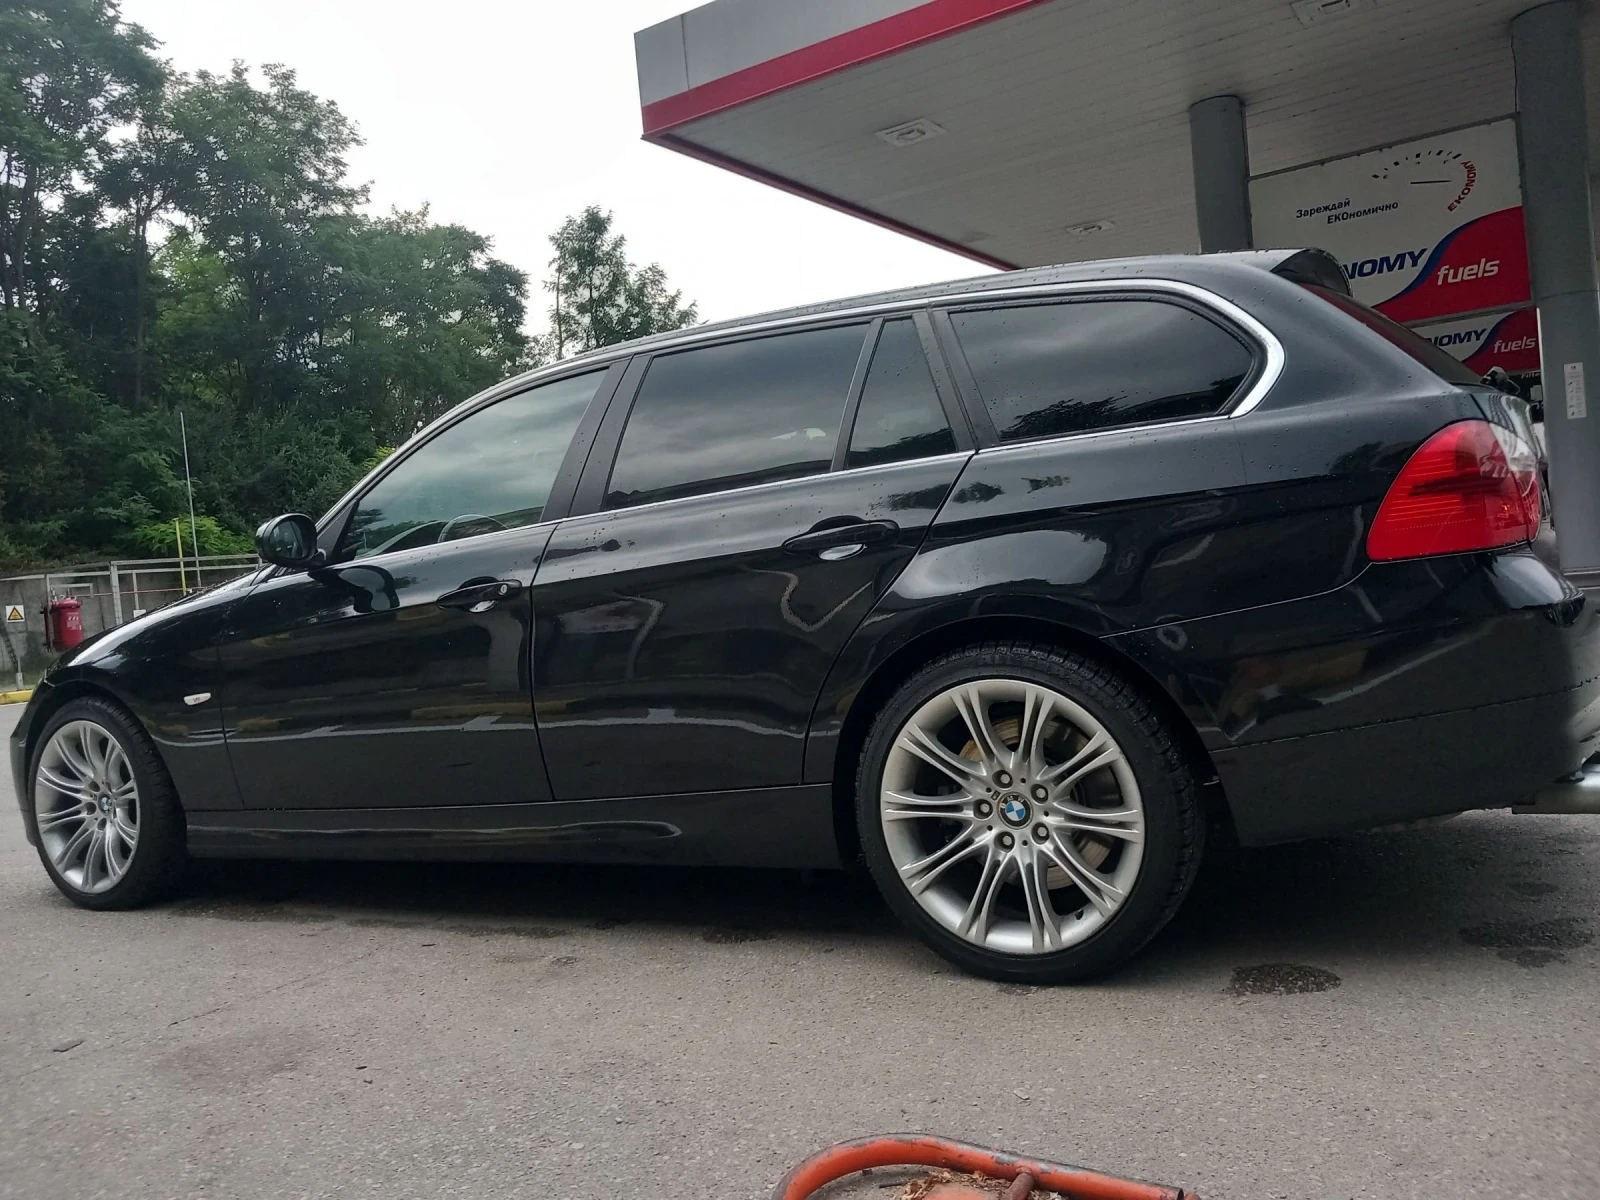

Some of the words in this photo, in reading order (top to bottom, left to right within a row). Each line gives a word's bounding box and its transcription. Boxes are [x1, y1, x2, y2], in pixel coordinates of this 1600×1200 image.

[1447, 160, 1477, 212] EKONOMY
[1296, 198, 1350, 218] Зареждай
[1327, 202, 1399, 224] ЕКОномично
[1437, 258, 1500, 285] fuels
[1493, 336, 1537, 353] fuels
